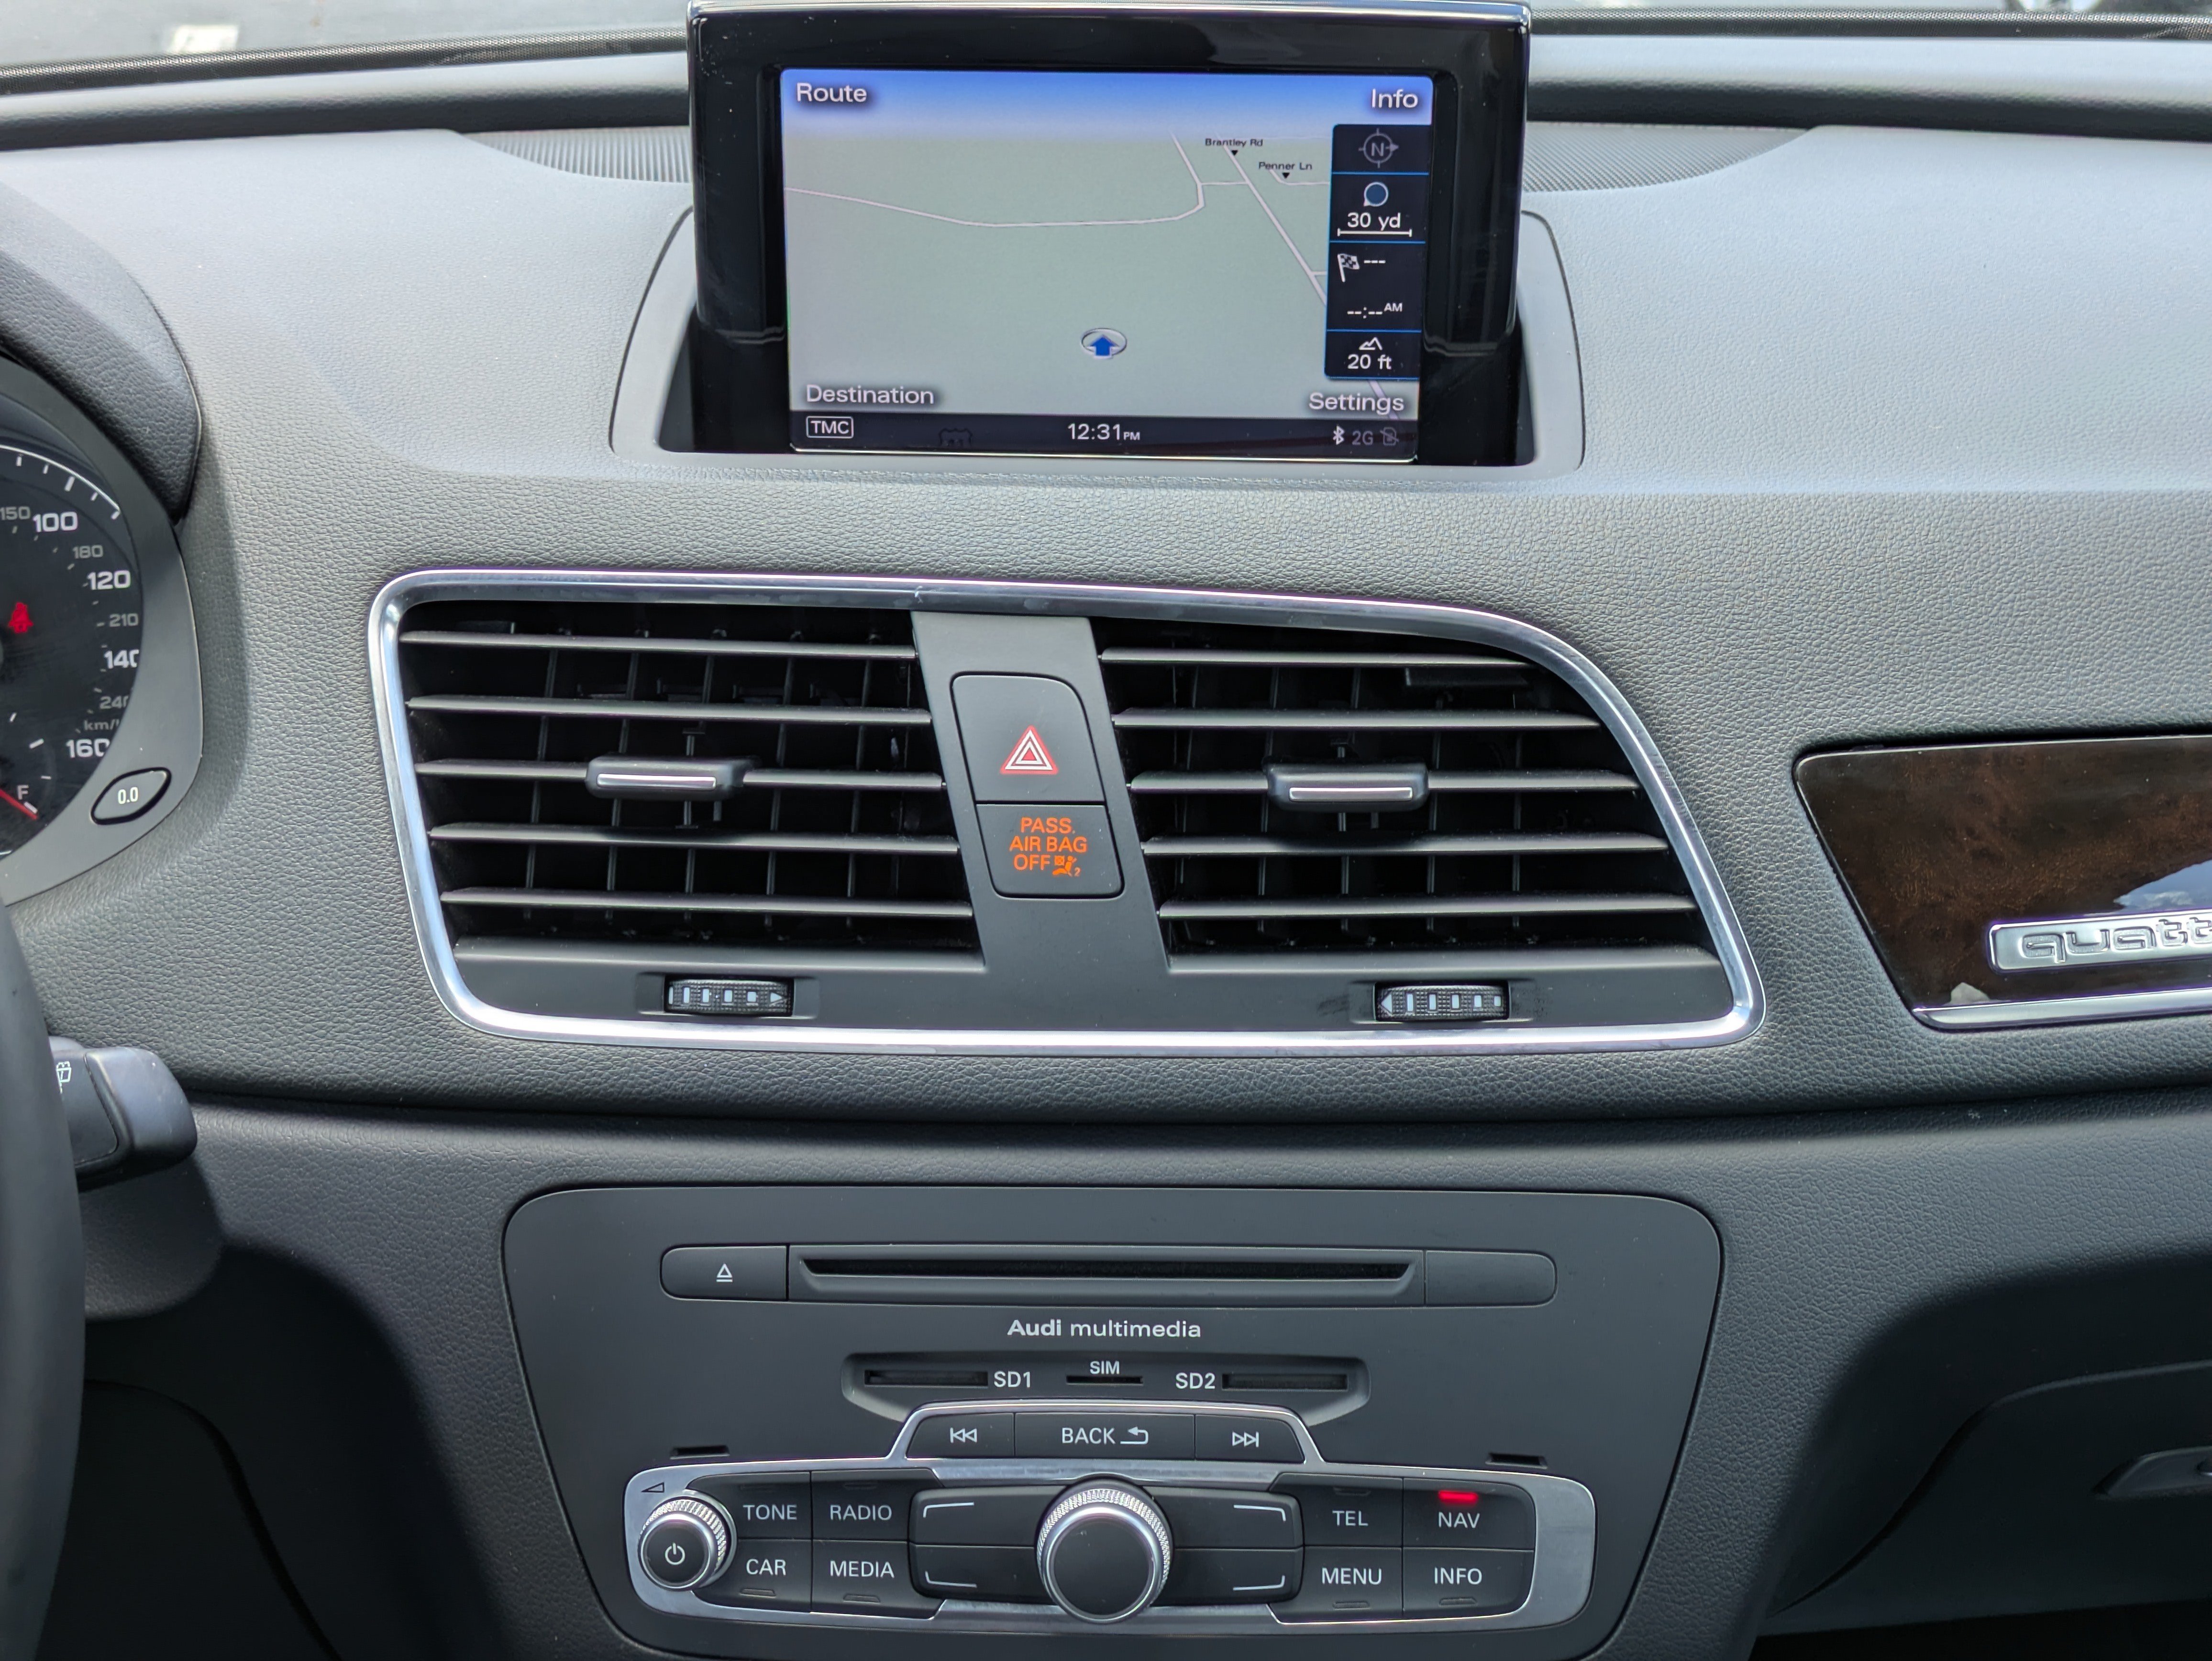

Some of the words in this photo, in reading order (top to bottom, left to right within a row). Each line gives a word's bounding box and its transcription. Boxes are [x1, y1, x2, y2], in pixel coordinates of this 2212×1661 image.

[796, 82, 868, 102] Route
[1371, 89, 1419, 109] Info
[1205, 138, 1247, 147] Brantley
[1250, 138, 1263, 147] Rd
[1371, 142, 1385, 157] N
[1258, 161, 1295, 170] Penner
[1299, 162, 1313, 170] Ln
[1347, 212, 1371, 228] 30
[1378, 212, 1401, 232] yd
[1347, 354, 1371, 369] 20
[1377, 354, 1392, 370] ft
[806, 384, 934, 404] Destination
[1308, 392, 1405, 415] Settings
[810, 420, 850, 434] TMC
[1351, 430, 1374, 446] 2G
[0, 506, 31, 520] 150
[32, 511, 78, 532] 100
[73, 544, 103, 559] 180
[87, 570, 131, 590] 120
[109, 613, 139, 627] 210
[99, 696, 129, 709] 24
[84, 719, 120, 731] km/
[17, 784, 29, 800] F
[117, 786, 139, 805] 0.0
[1020, 816, 1072, 834] PASS
[1009, 835, 1041, 853] AIR
[1046, 836, 1087, 854] BAG
[1013, 853, 1051, 871] OFF
[1007, 1319, 1062, 1337] Audi
[1070, 1319, 1202, 1338] multimedia
[1089, 1361, 1120, 1375] SIM
[993, 1371, 1032, 1388] SD1
[1174, 1373, 1216, 1389] SD2
[1061, 1428, 1116, 1445] BACK
[742, 1505, 797, 1520] TONE
[830, 1505, 892, 1521] RADIO
[1332, 1510, 1369, 1527] TEL
[1438, 1511, 1481, 1528] NAV
[745, 1559, 786, 1576] CAR
[830, 1561, 895, 1578] MEDIA
[1321, 1568, 1383, 1585] MENU
[1434, 1568, 1483, 1585] INFO
